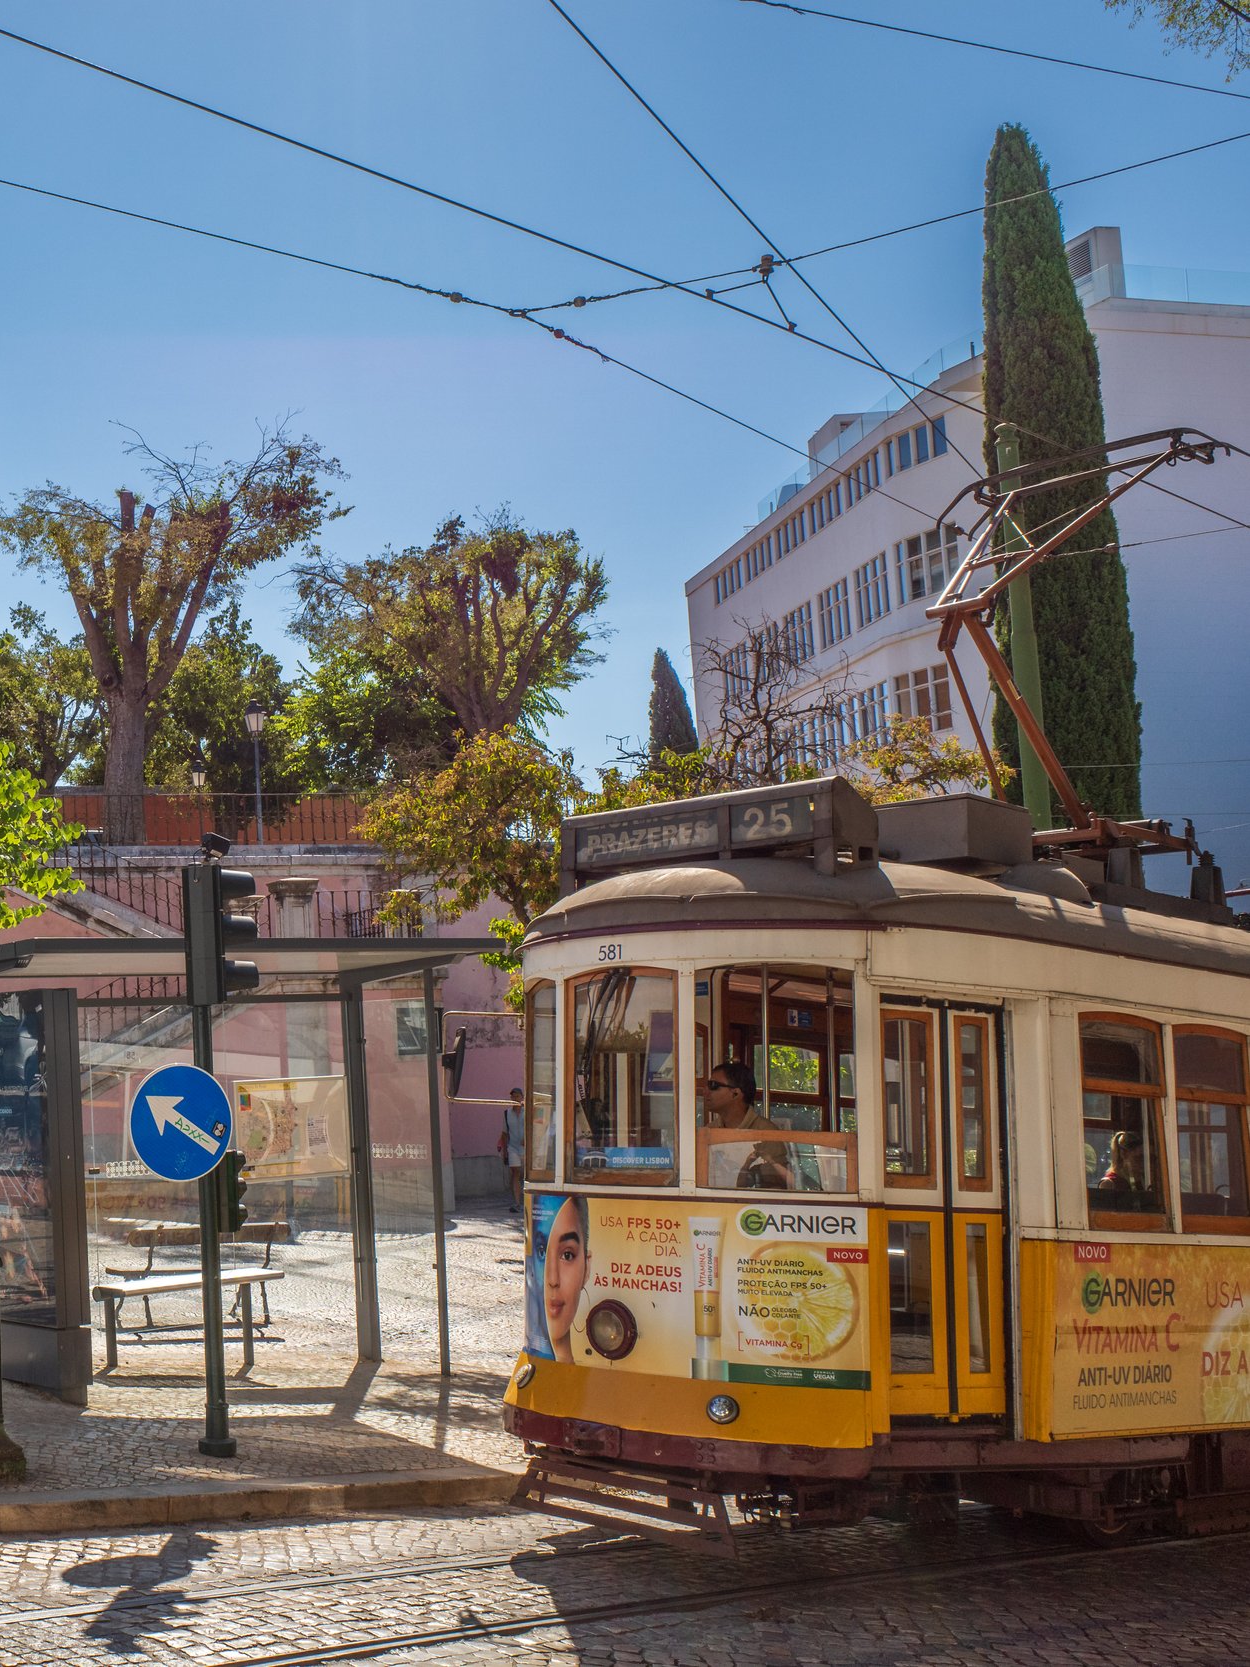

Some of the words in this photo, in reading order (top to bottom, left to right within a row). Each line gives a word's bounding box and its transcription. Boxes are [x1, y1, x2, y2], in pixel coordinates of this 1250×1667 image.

[744, 803, 792, 839] 25
[586, 820, 710, 856] PRAZERES
[598, 944, 623, 961] 581
[612, 1156, 644, 1165] DISCOVER
[645, 1156, 670, 1165] LISBON
[600, 1216, 623, 1228] USA
[628, 1217, 651, 1229] FPS
[656, 1219, 681, 1230] 50+
[744, 1212, 857, 1235] GARNIER
[626, 1232, 636, 1241] A
[639, 1232, 681, 1244] CADA.
[654, 1246, 681, 1258] DIA.
[833, 1252, 863, 1260] NOVO
[1078, 1246, 1107, 1259] NOVO
[611, 1262, 632, 1274] DIZ
[635, 1264, 682, 1278] ADEUS
[698, 1253, 706, 1288] VITAMINA
[737, 1258, 772, 1266] ANTI-UV
[774, 1259, 805, 1267] DIÁRIO
[594, 1273, 608, 1287] ÀS
[612, 1277, 682, 1293] MANCHAS!
[737, 1279, 788, 1289] PROTEÇÃO
[1085, 1278, 1175, 1308] GARNIER
[1206, 1281, 1244, 1308] USA
[738, 1304, 770, 1318] NÃO
[745, 1339, 788, 1348] VITAMINA
[1072, 1318, 1159, 1354] VITAMINA
[1202, 1351, 1231, 1377] DIZ
[1078, 1365, 1131, 1387] ANTI-UV
[1133, 1360, 1172, 1384] DIÁRIO
[1073, 1394, 1106, 1410] FLUIDO
[1109, 1390, 1177, 1408] ANTIMANCHAS
